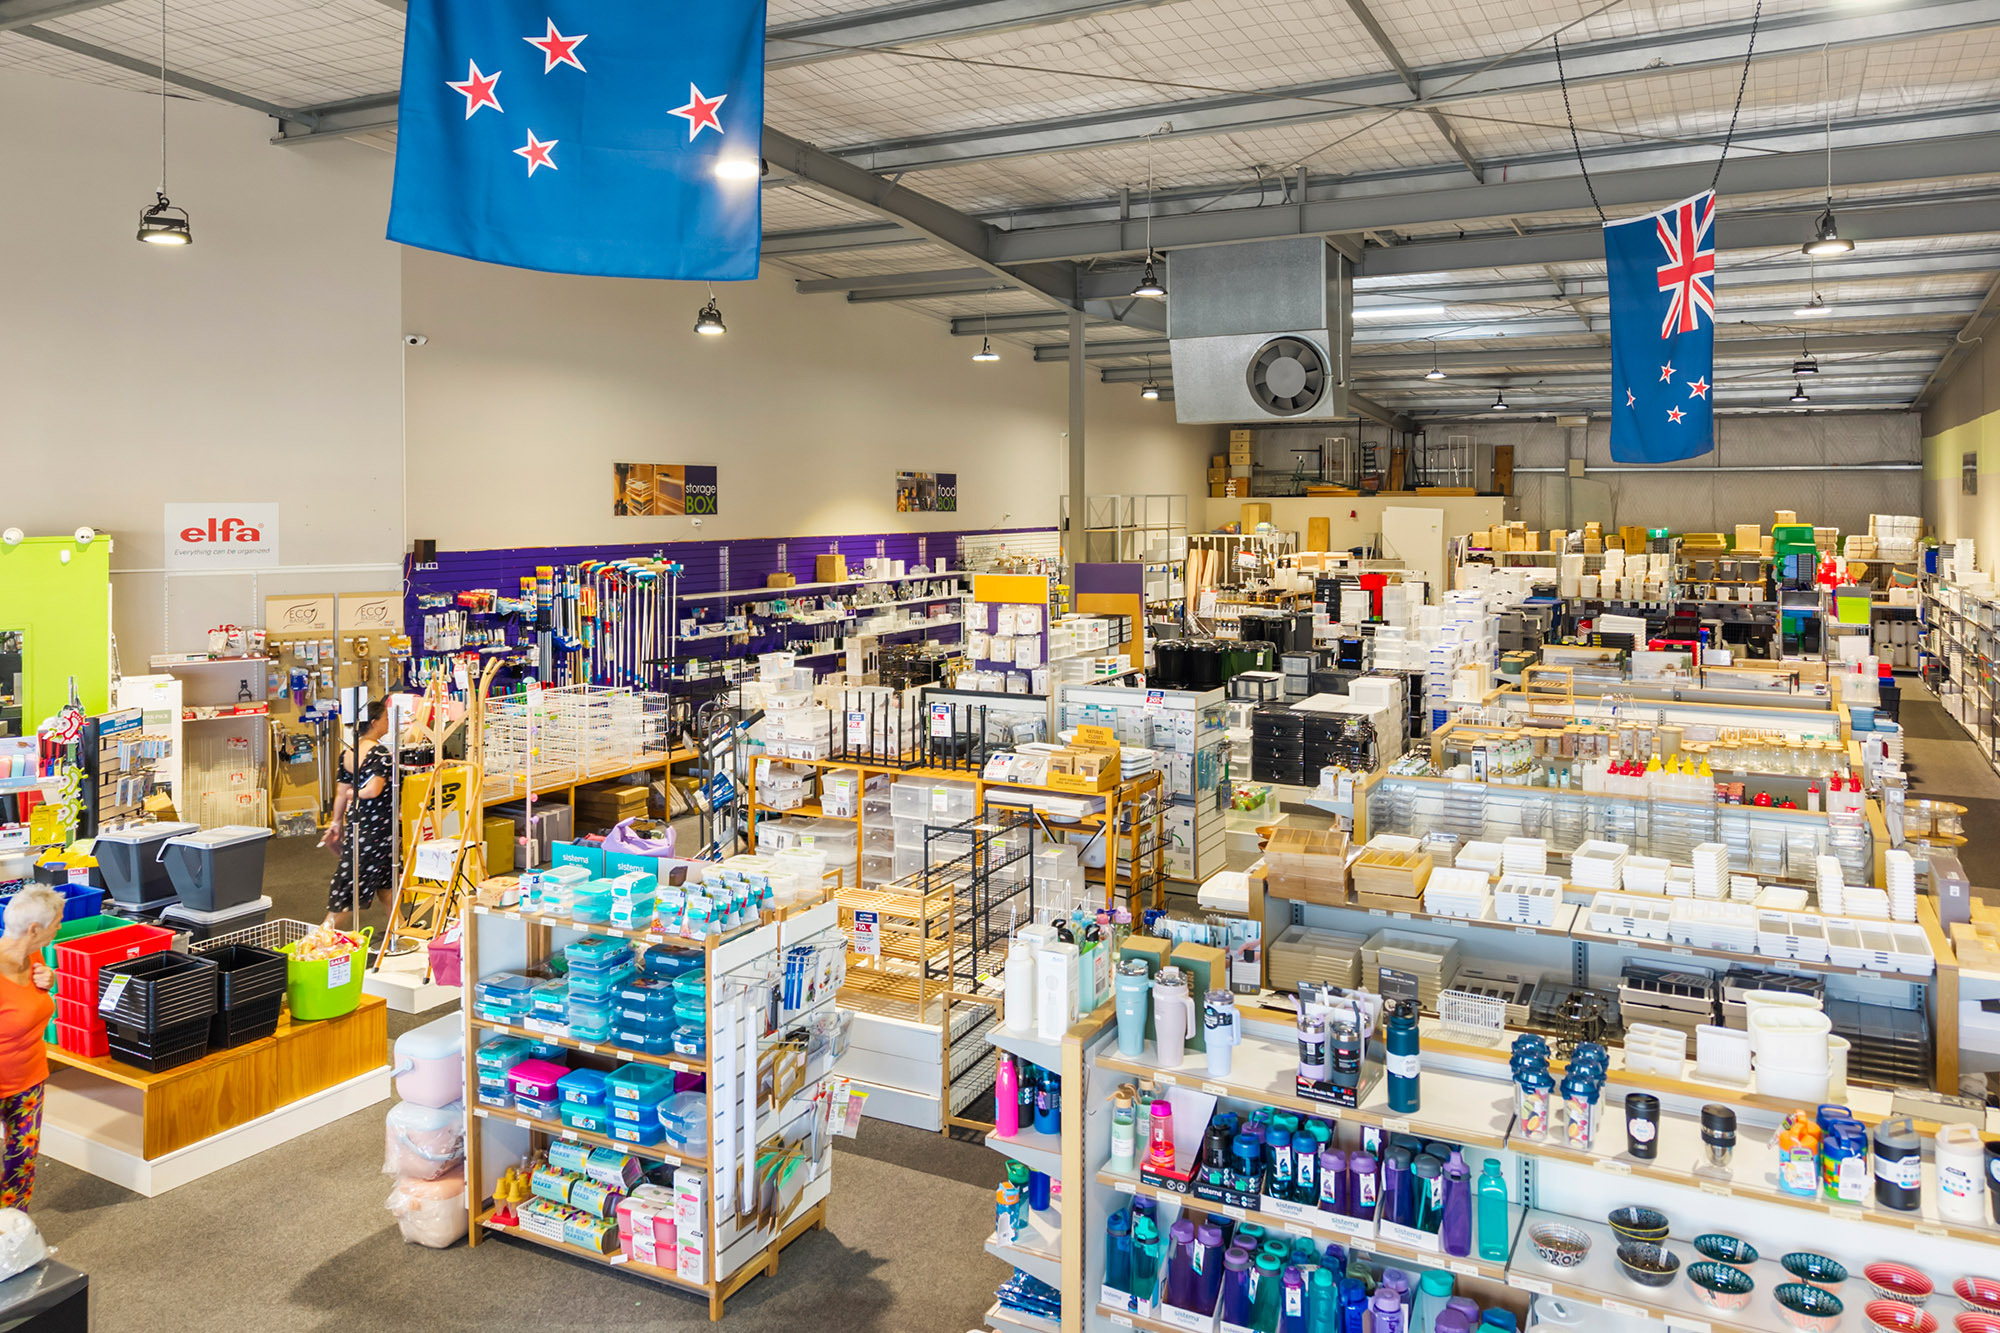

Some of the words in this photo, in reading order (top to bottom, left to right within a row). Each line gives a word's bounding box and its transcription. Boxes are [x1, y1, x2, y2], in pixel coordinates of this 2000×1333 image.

[685, 483, 716, 496] storage
[938, 484, 956, 497] food
[686, 496, 716, 513] BOX
[938, 497, 955, 511] BOX
[180, 517, 260, 543] elfa
[174, 548, 212, 557] Everything
[237, 547, 270, 556] organized
[289, 608, 313, 619] ECO
[360, 606, 384, 617] ECO
[1086, 728, 1104, 736] NATURAL
[562, 853, 589, 864] sistema
[617, 862, 644, 873] sistema
[551, 1149, 570, 1158] MAKER
[532, 1180, 551, 1189] MAKER
[575, 1183, 583, 1191] ICE
[583, 1185, 599, 1196] BLOCK
[574, 1190, 589, 1200] MAKER
[1198, 1186, 1222, 1197] sistema
[1275, 1201, 1303, 1213] sistema
[1331, 1216, 1359, 1229] sistema
[565, 1225, 575, 1233] ICE
[575, 1227, 594, 1238] BLOCK
[565, 1231, 584, 1241] MAKER
[1394, 1226, 1422, 1240] sistema
[1104, 1290, 1122, 1300] sistema
[1174, 1310, 1200, 1322] sistema
